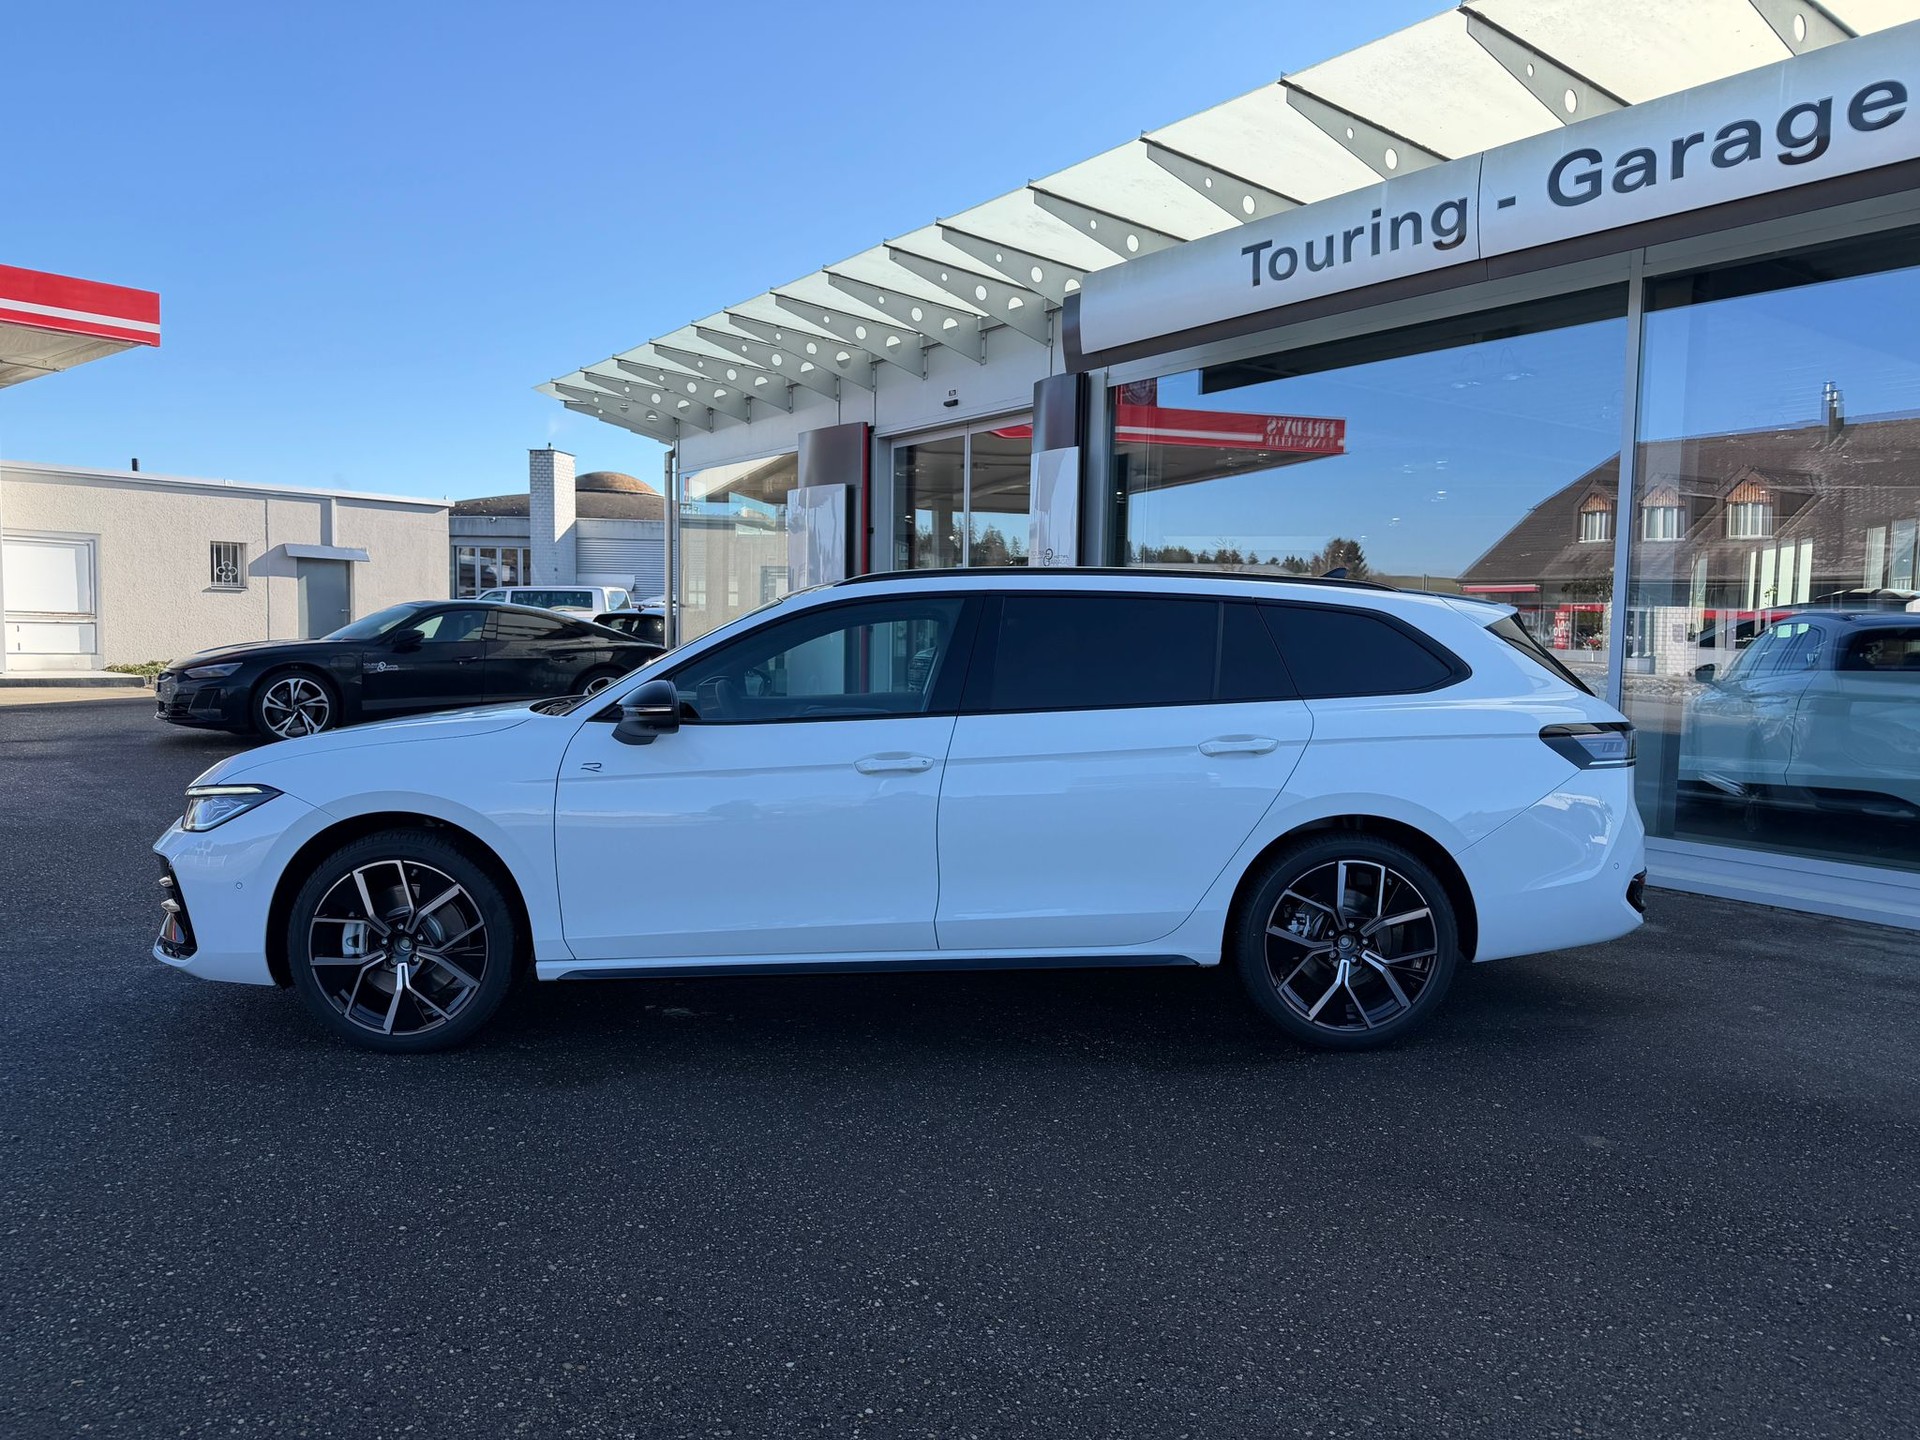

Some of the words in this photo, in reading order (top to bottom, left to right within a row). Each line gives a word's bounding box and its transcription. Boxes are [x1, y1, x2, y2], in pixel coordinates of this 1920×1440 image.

[1241, 195, 1468, 286] Touring
[1497, 196, 1517, 211] -
[1545, 79, 1909, 208] Garage
